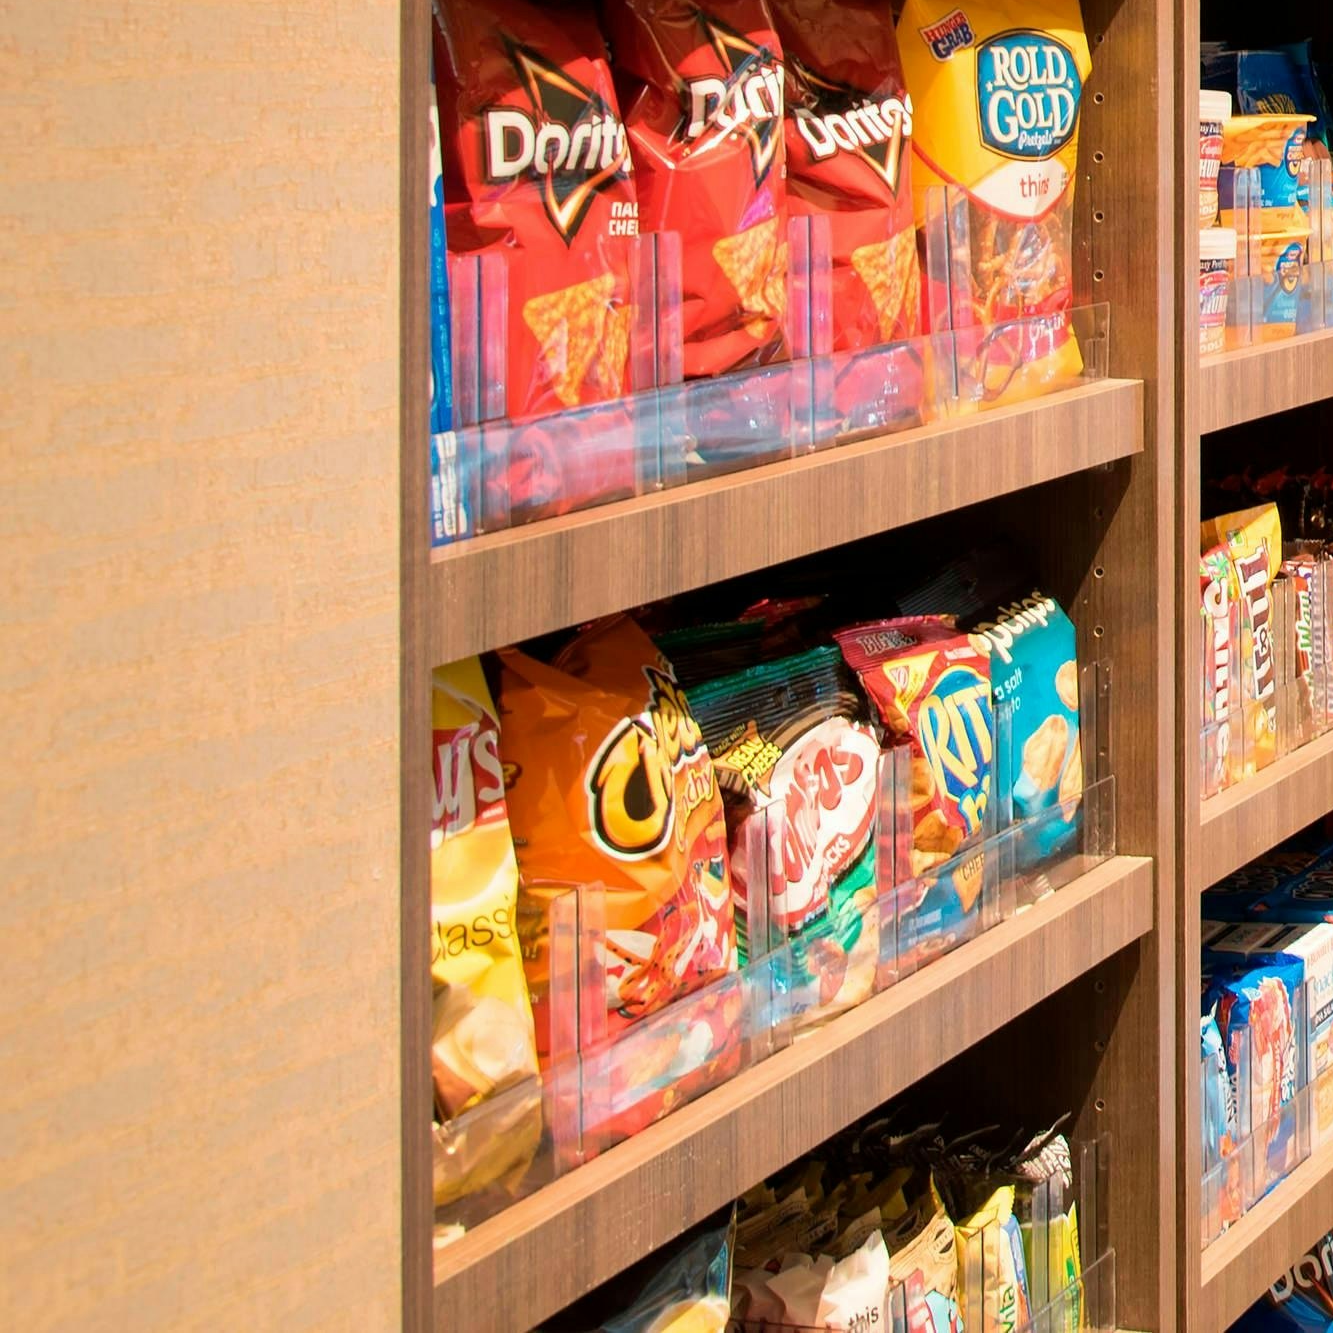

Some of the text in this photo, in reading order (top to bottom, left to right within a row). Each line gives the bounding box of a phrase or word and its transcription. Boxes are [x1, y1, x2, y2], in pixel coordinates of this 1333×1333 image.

[933, 23, 975, 60] GRAB
[989, 45, 1068, 91] ROLD
[688, 63, 784, 138] Dori
[988, 87, 1076, 144] GOLD
[487, 110, 635, 178] Dorito
[1018, 129, 1053, 150] Pretzels
[1003, 666, 1023, 695] salt
[727, 736, 765, 768] REAL
[917, 683, 994, 792] RIT
[740, 741, 784, 785] CHEESE
